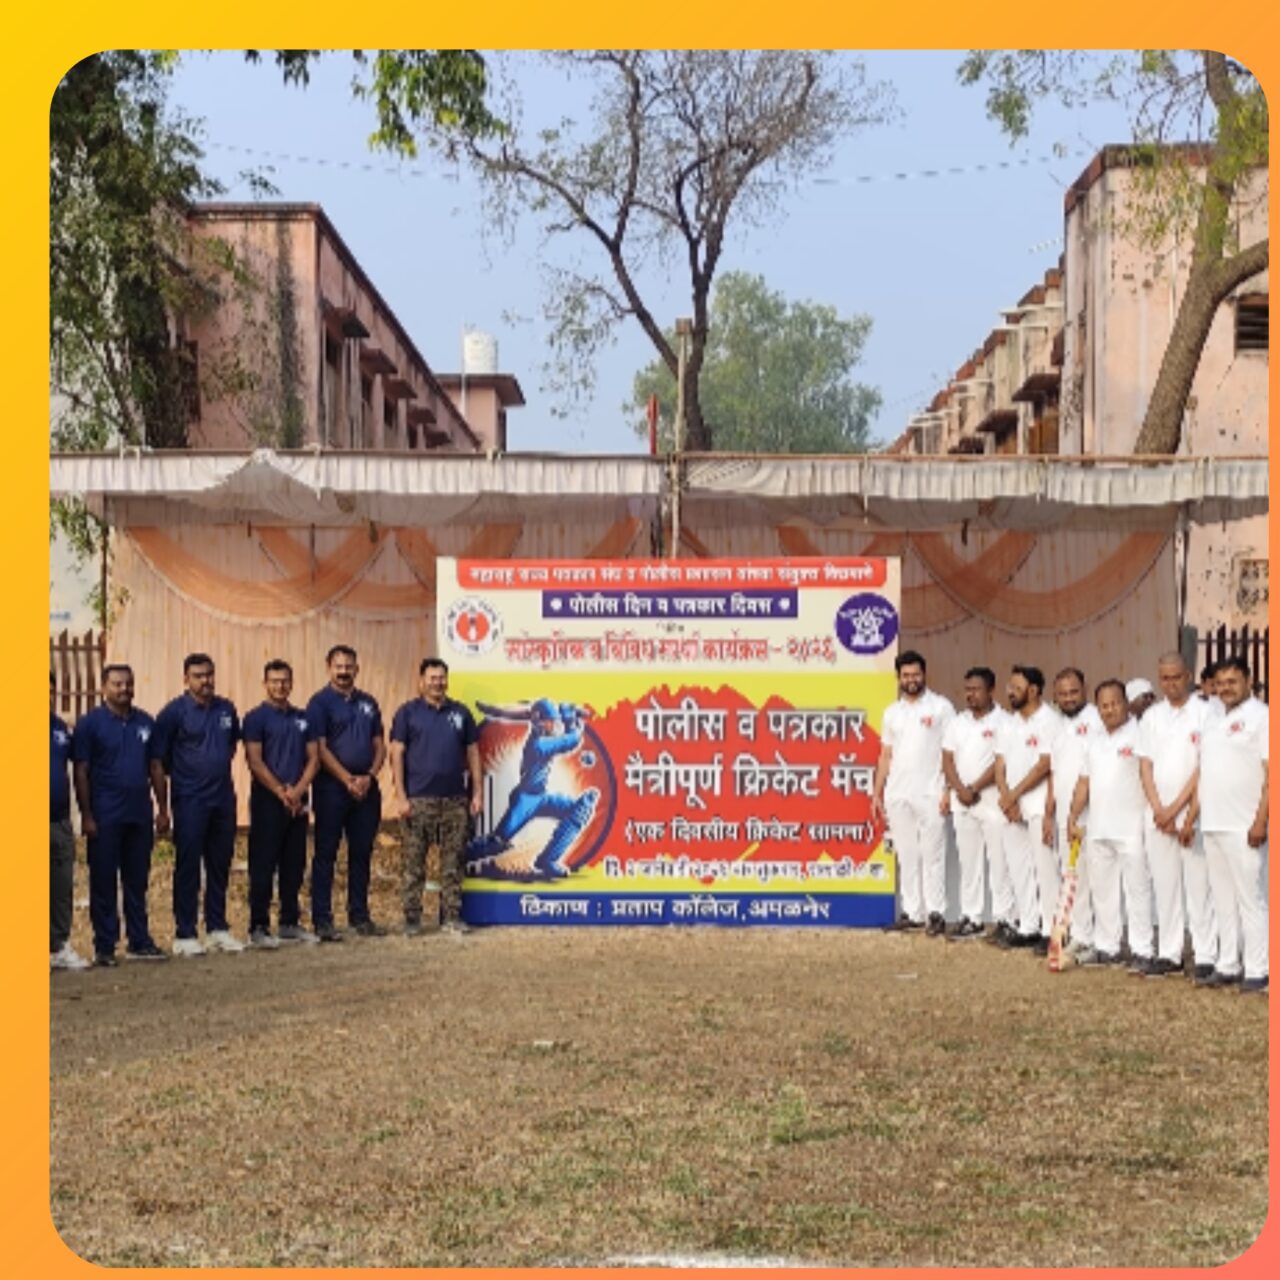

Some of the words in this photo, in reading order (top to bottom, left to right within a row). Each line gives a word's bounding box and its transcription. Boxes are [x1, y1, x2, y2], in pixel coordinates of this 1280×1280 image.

[569, 592, 618, 614] पोलीस
[673, 596, 726, 615] पत्रकार
[635, 696, 725, 742] पोलीस
[736, 708, 757, 740] व
[767, 707, 866, 743] पत्रकार
[625, 751, 723, 808] मैत्रीपूर्ण
[733, 752, 820, 797] क्रिकेट
